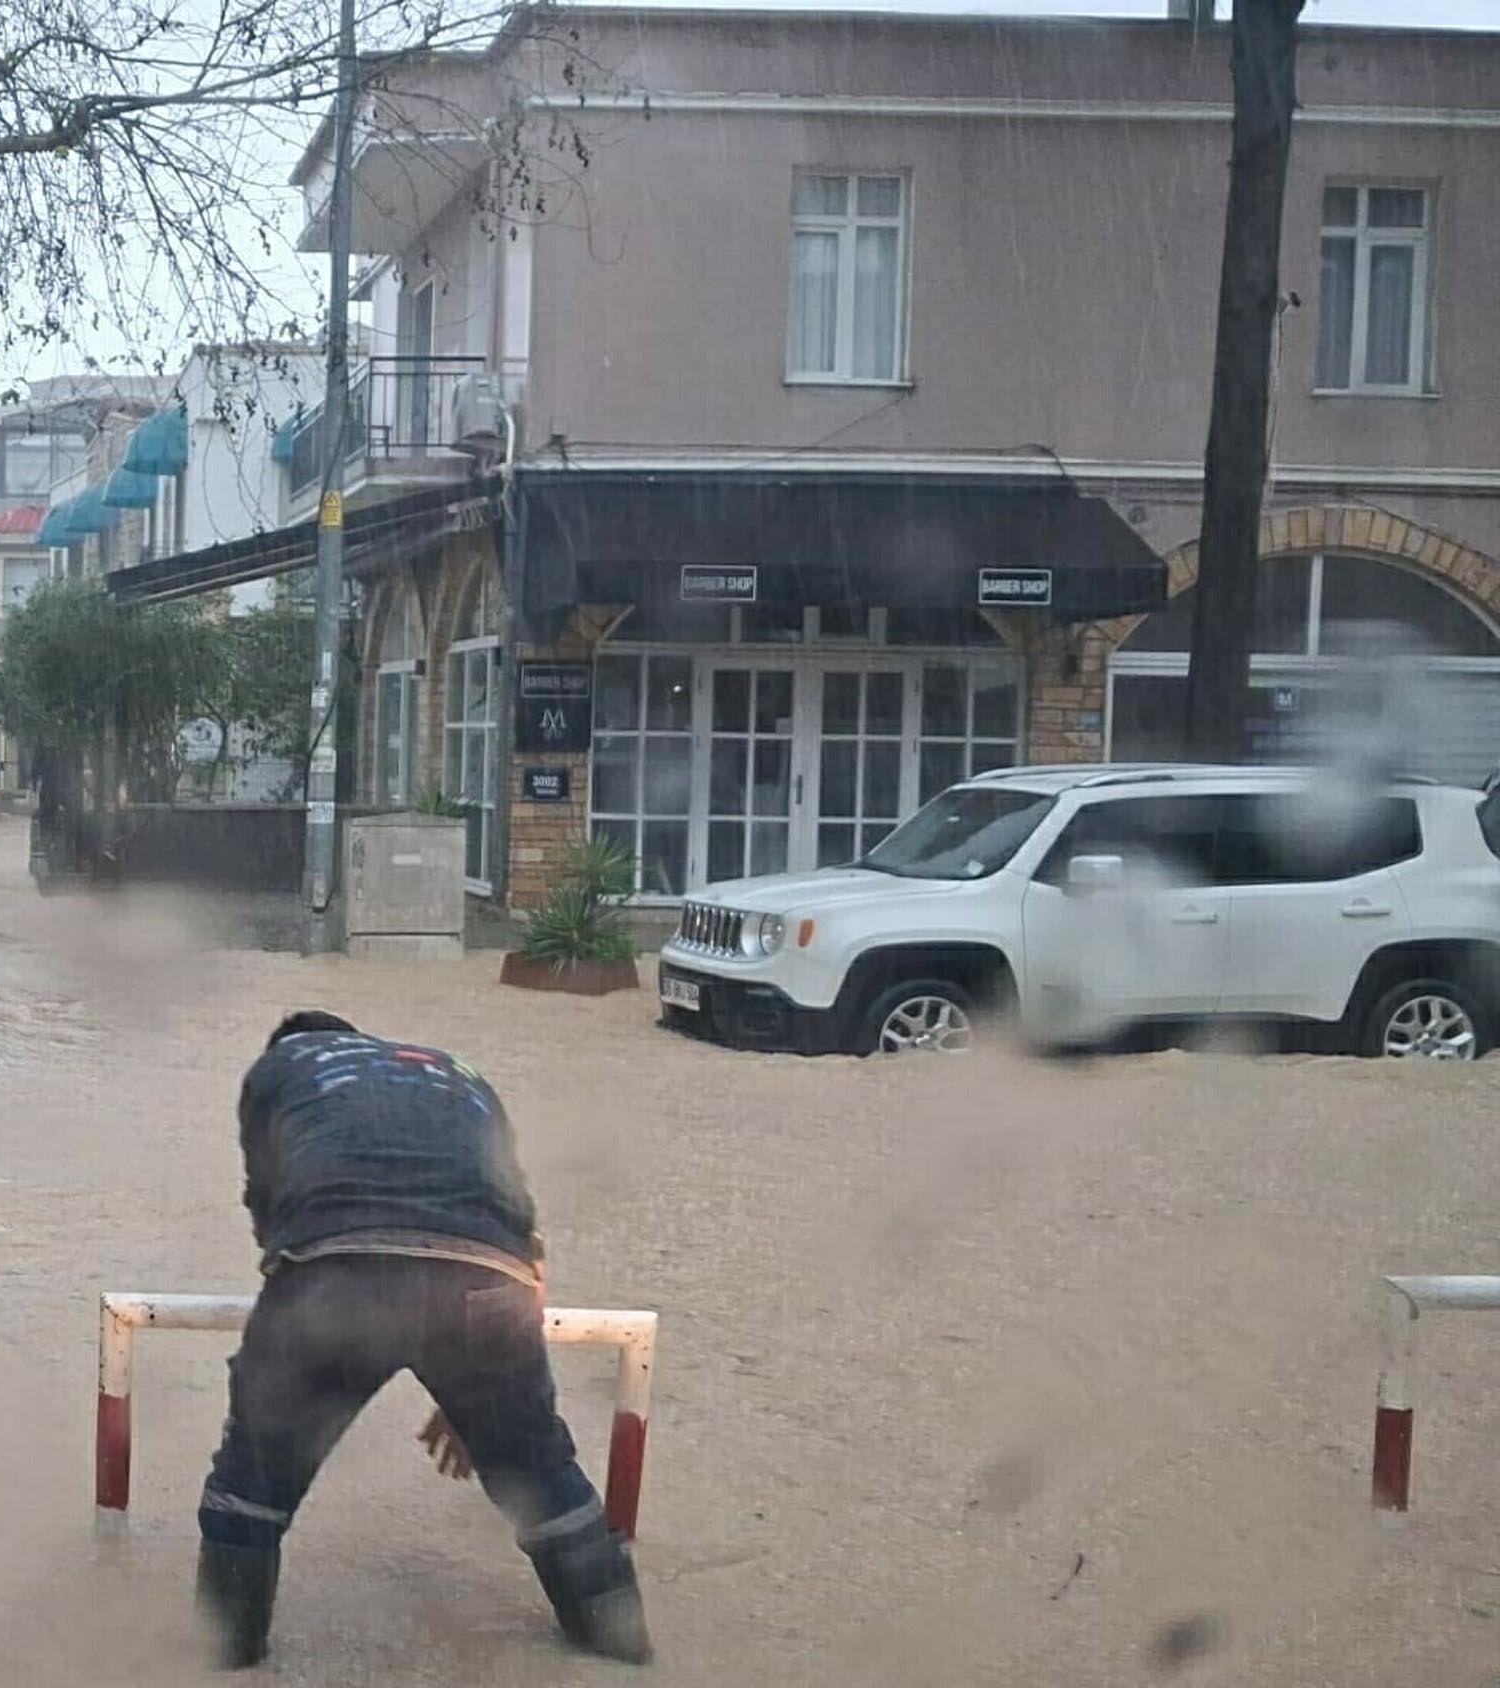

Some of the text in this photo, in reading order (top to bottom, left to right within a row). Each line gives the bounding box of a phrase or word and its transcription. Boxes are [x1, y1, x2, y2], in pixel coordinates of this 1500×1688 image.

[726, 575, 753, 592] SHOP
[982, 578, 1049, 595] BARBER SHOP
